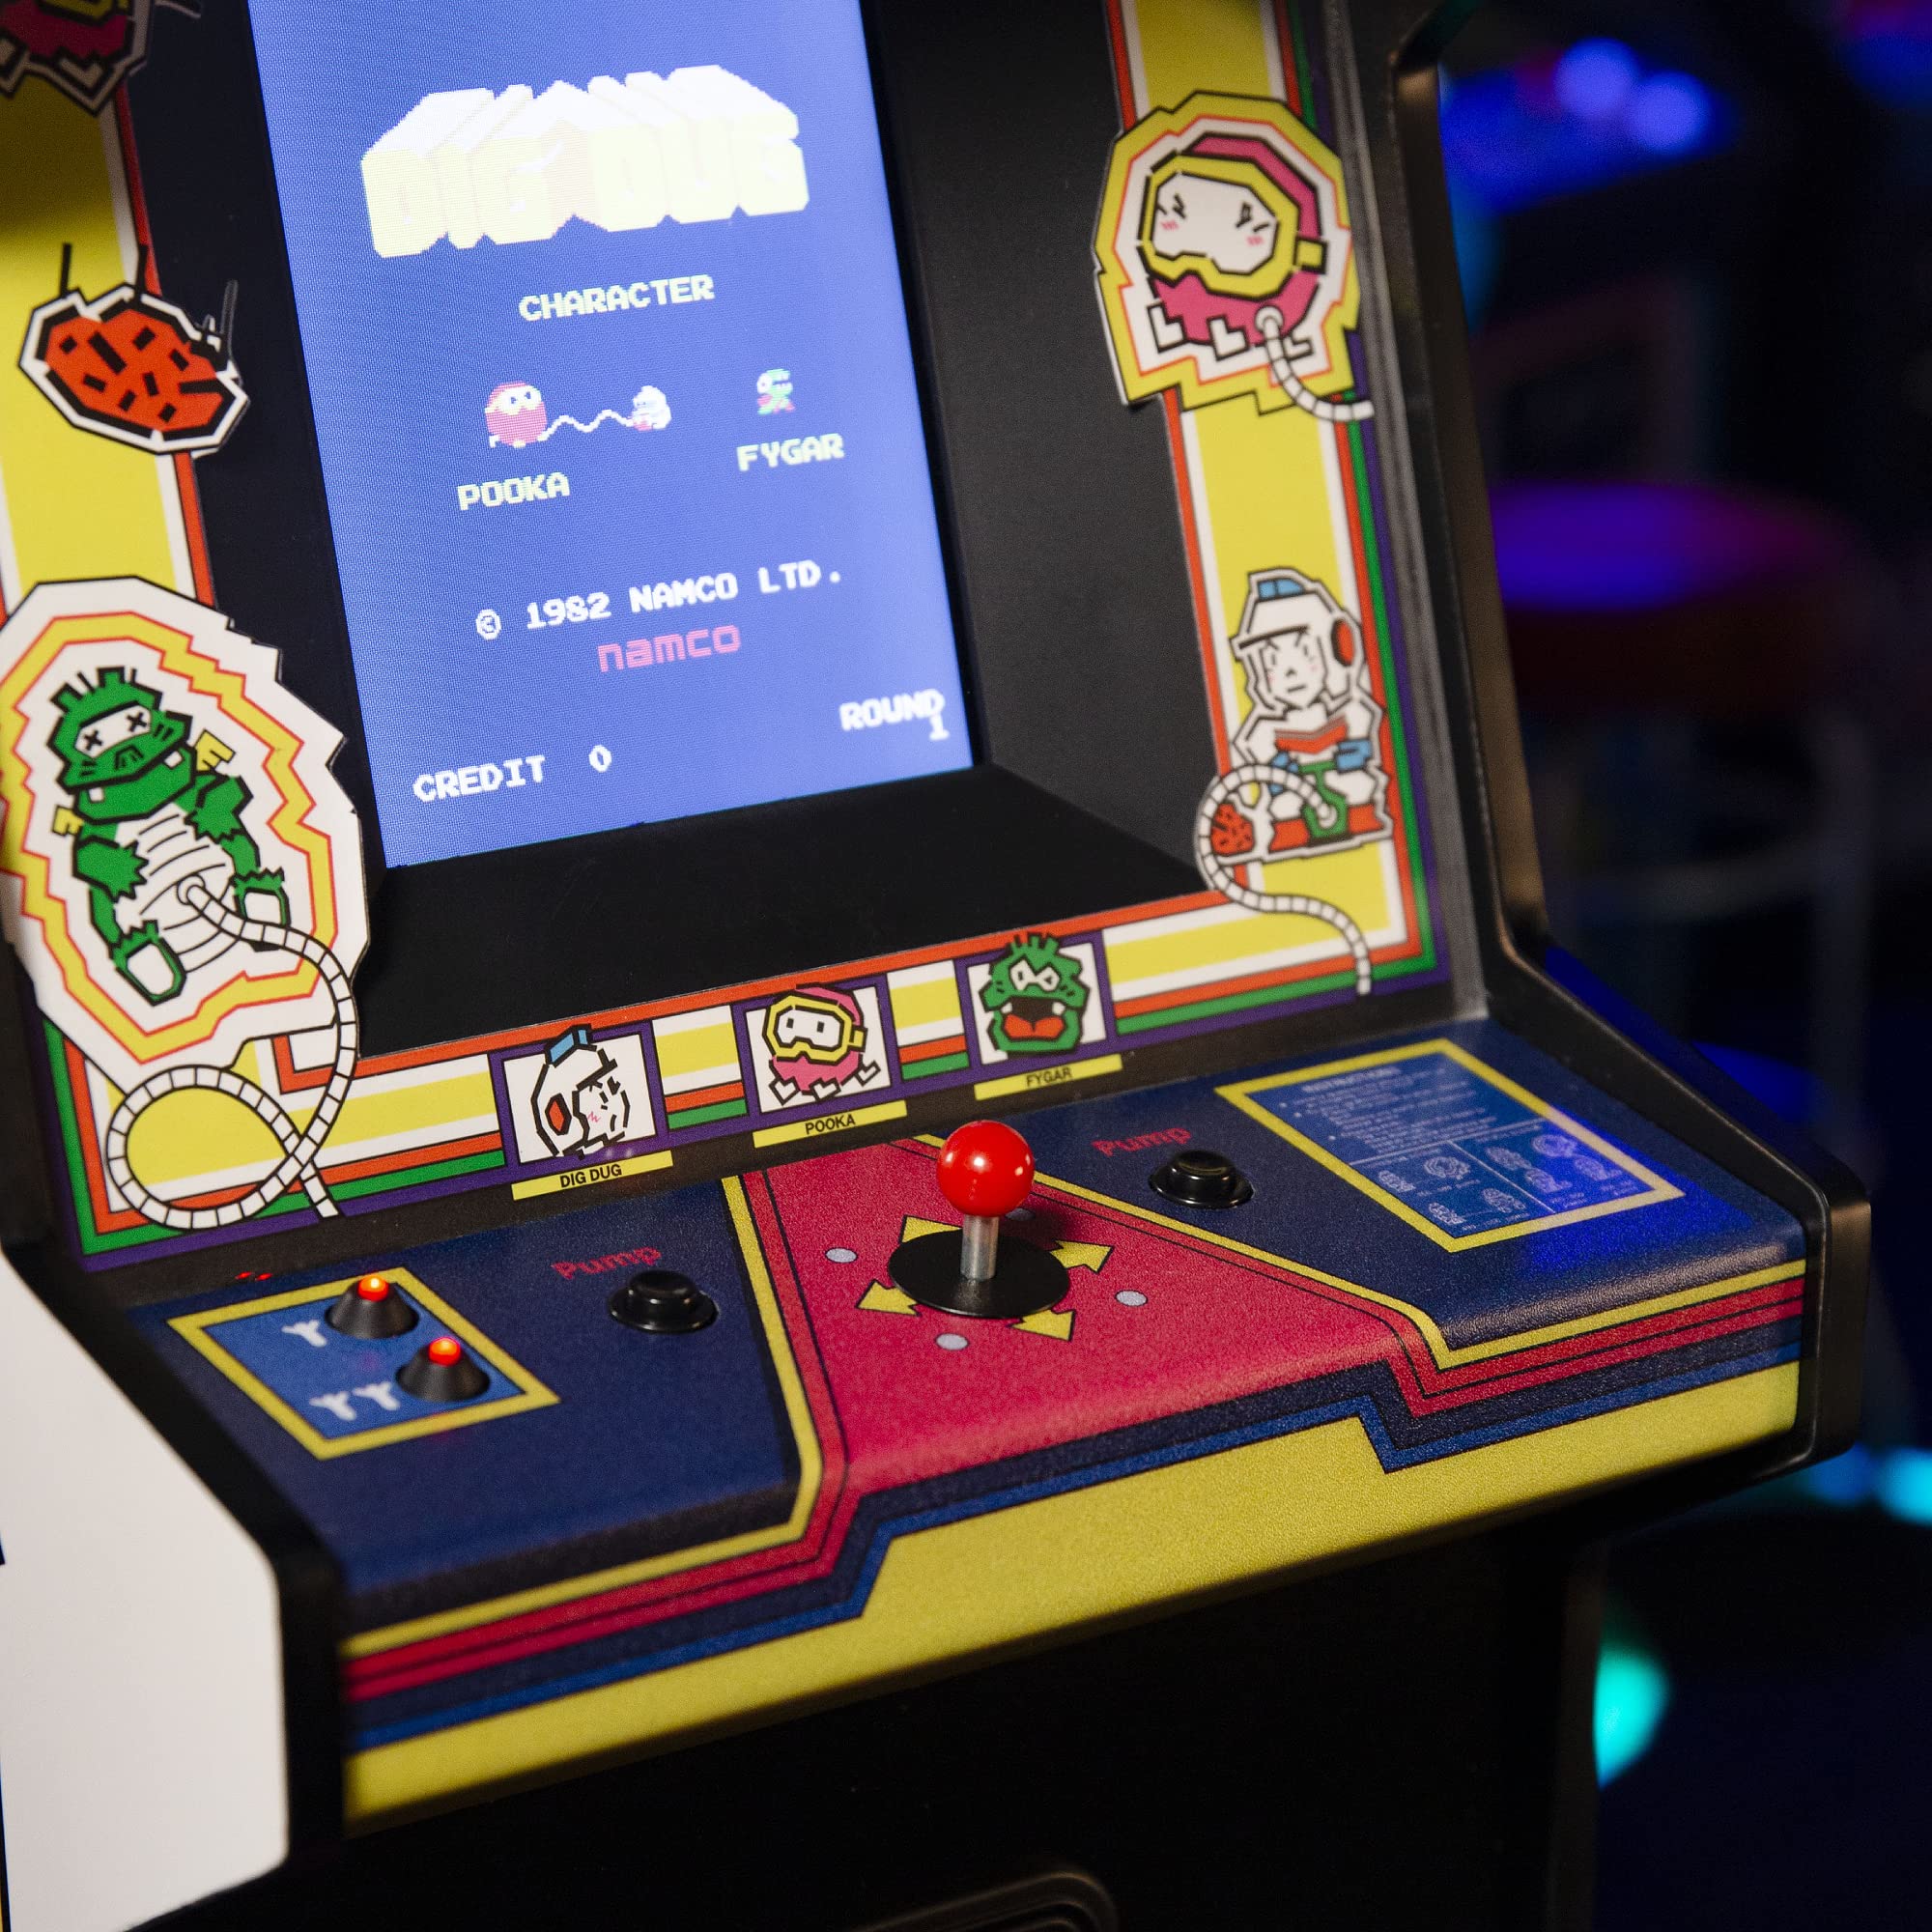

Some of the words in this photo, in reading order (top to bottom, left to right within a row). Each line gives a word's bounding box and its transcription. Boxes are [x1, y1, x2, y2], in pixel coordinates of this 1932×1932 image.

[361, 111, 558, 258] DIG
[585, 89, 810, 233] DUG
[519, 274, 715, 321] CHARACTER
[736, 433, 845, 471] FYGAR
[457, 471, 571, 511] POOKA
[526, 592, 611, 629] 1982
[629, 572, 738, 612] NAMCO
[758, 559, 841, 594] LTD.
[597, 624, 741, 672] namco
[838, 688, 946, 731] ROUND
[928, 712, 951, 741] 1
[412, 753, 546, 803] CREDIT
[1026, 1066, 1073, 1087] FYGAR
[805, 1113, 857, 1135] POOKA
[1092, 1127, 1191, 1157] Pump
[560, 1171, 587, 1188] DIG
[589, 1163, 623, 1181] DUG
[552, 1246, 663, 1280] Pump
